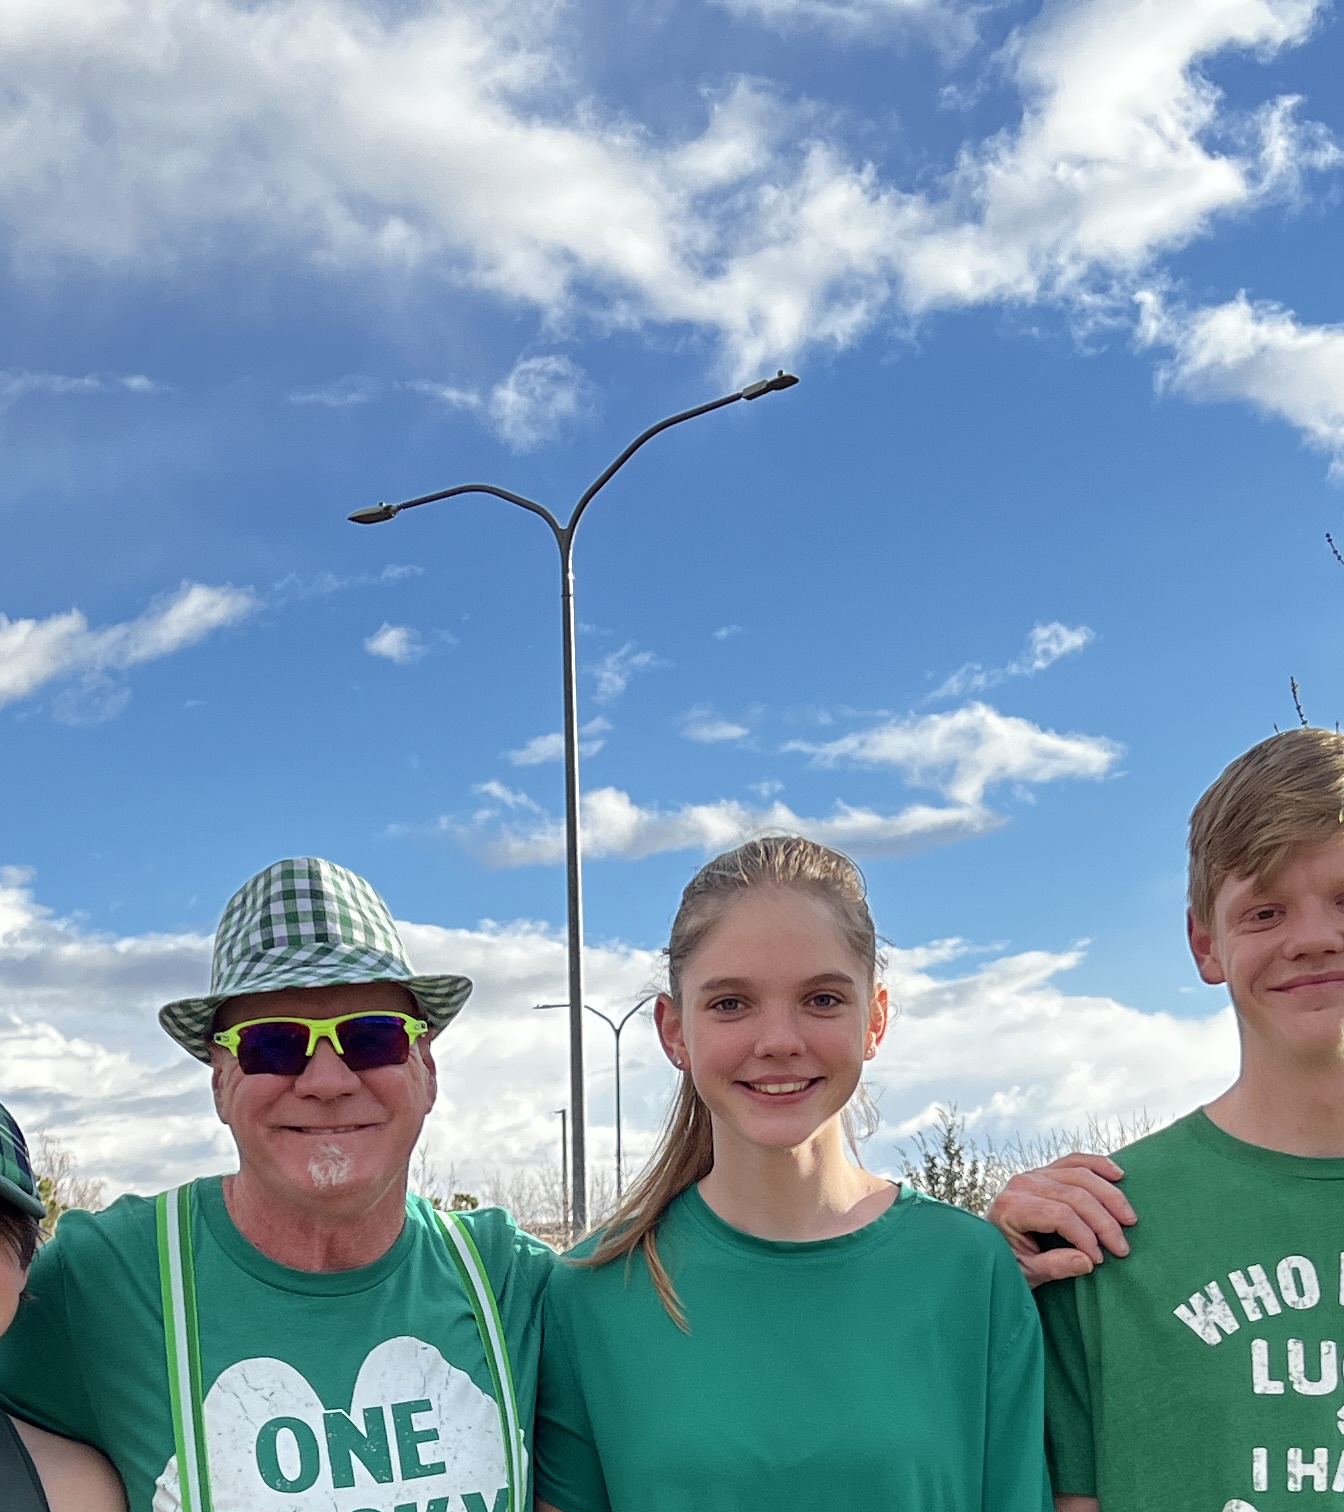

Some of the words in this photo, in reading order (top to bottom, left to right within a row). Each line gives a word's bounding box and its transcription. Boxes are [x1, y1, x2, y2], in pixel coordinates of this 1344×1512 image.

[1173, 1254, 1321, 1346] WHO
[255, 1398, 446, 1493] ONE
[1251, 1447, 1268, 1492] I
